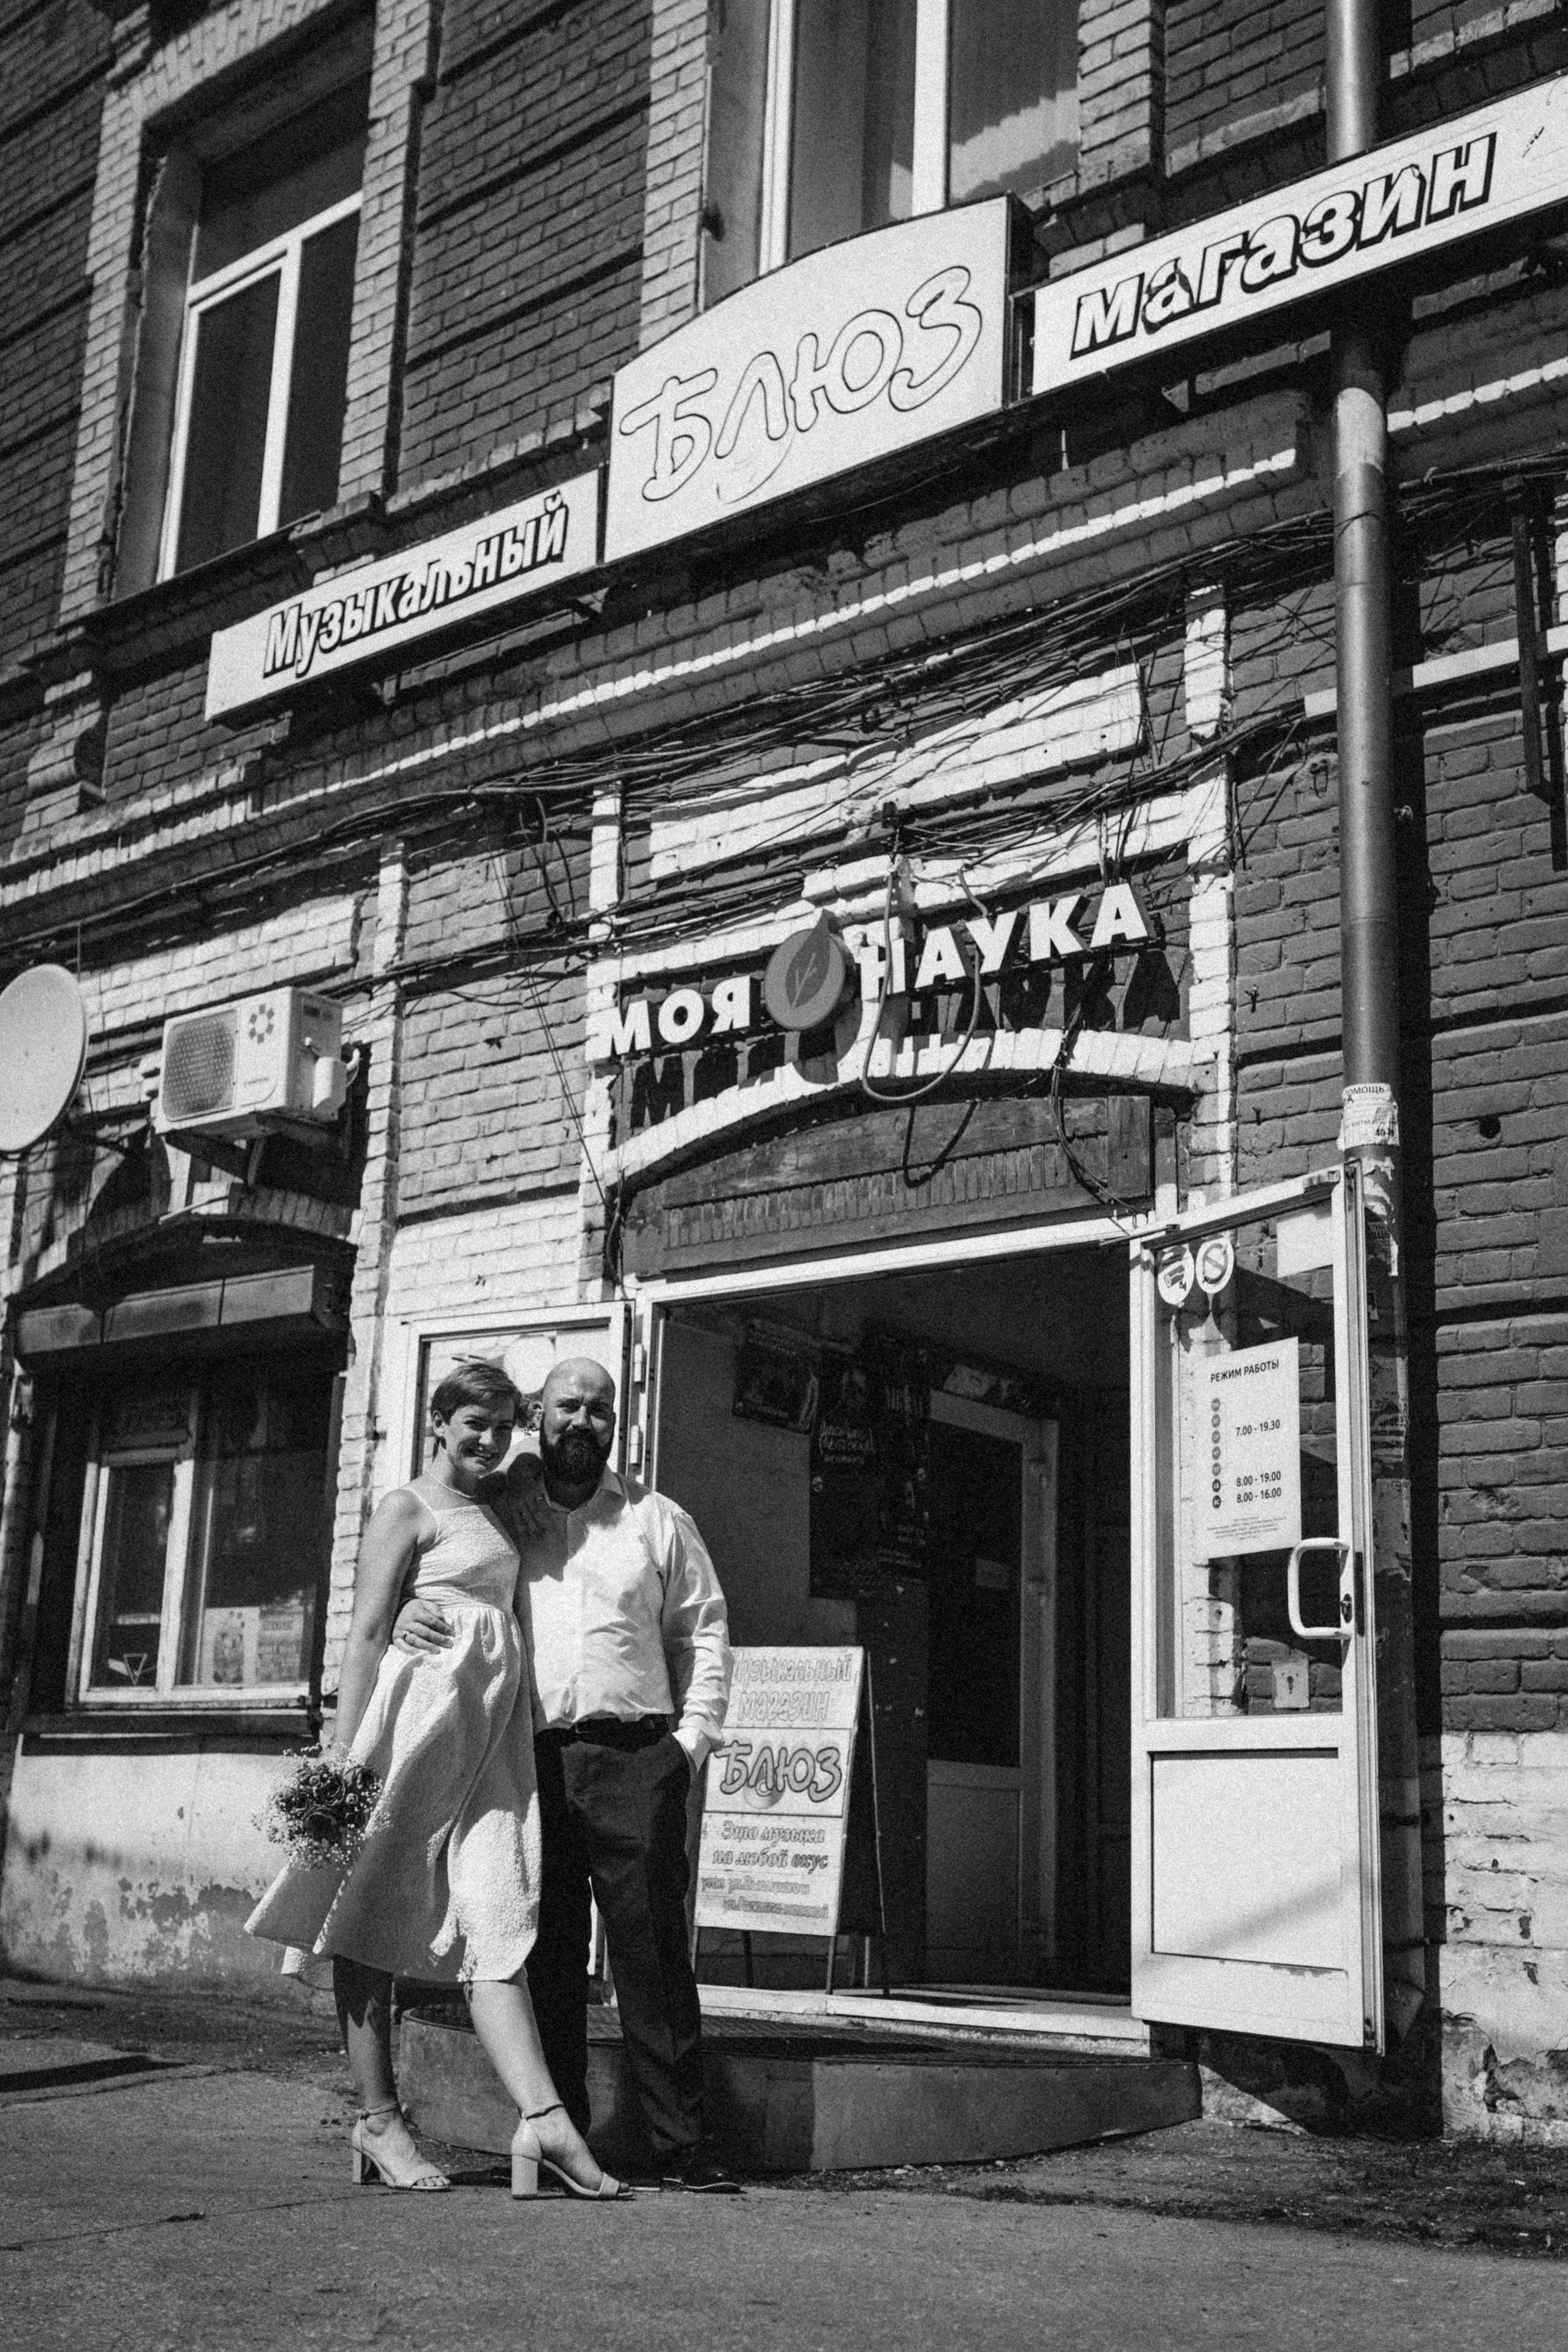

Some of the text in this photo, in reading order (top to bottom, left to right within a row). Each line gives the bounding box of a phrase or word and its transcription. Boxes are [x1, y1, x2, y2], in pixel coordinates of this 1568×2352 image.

[263, 491, 568, 677] Музыкальный
[619, 265, 982, 502] БЛЮЗ
[612, 883, 1148, 1055] МОЯ НАУКА
[1211, 1359, 1279, 1382] РЕЖИМ РАБОТЫ
[1236, 1425, 1252, 1436] 7.00
[1260, 1419, 1280, 1432] 19.30
[1237, 1476, 1253, 1487] 8.00
[1260, 1471, 1281, 1483] 19.00
[1237, 1491, 1253, 1503] 8.00
[1261, 1487, 1281, 1499] 16.00
[715, 1740, 842, 1803] БЛЮЗ
[712, 1847, 829, 1875] на любой вкус
